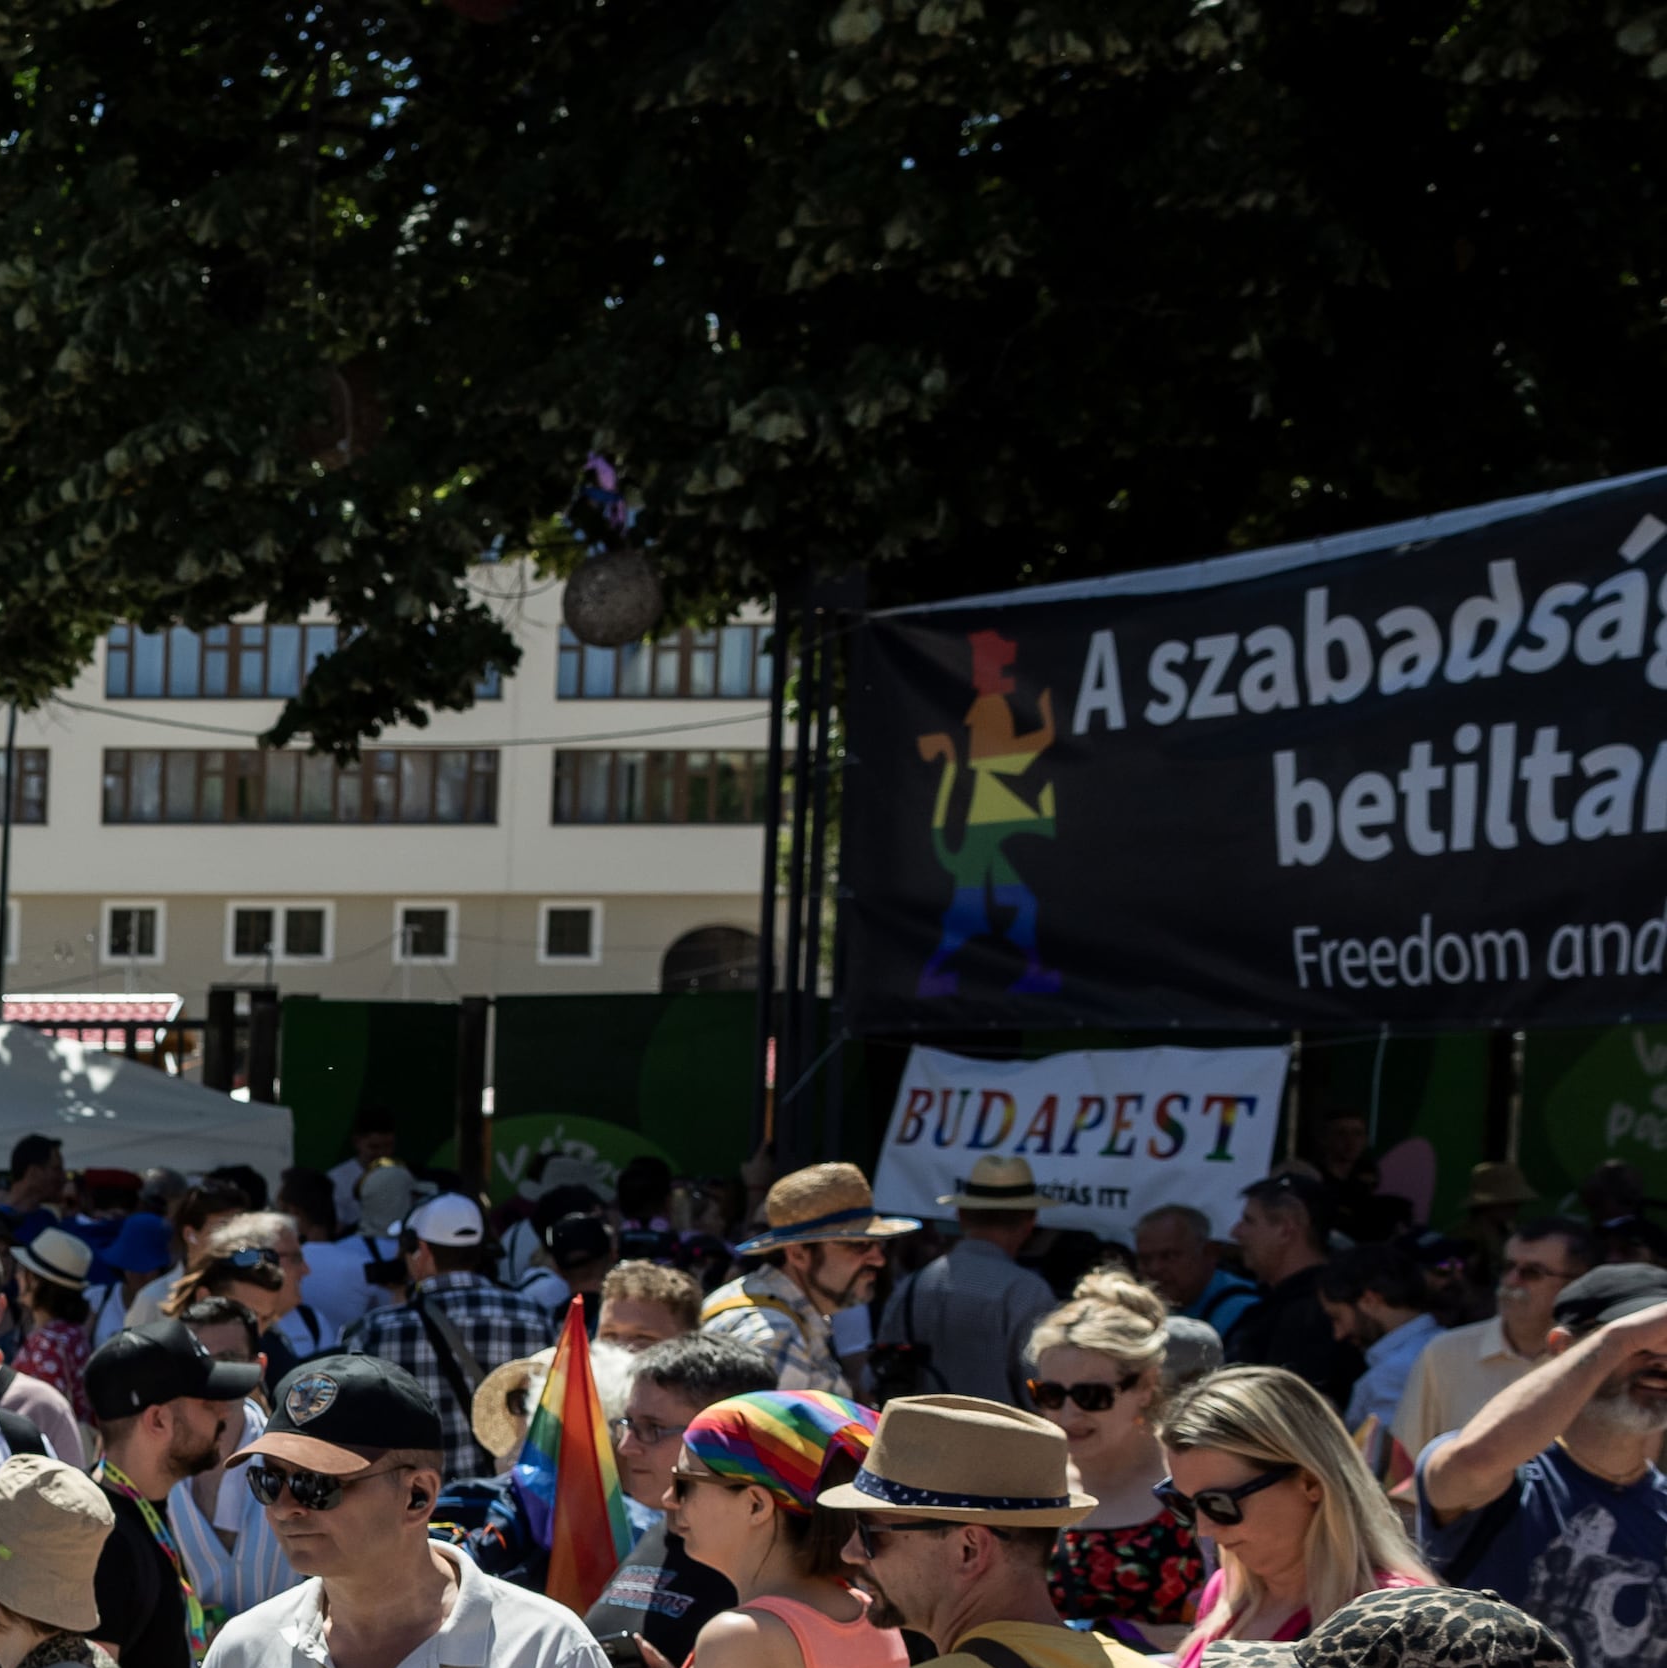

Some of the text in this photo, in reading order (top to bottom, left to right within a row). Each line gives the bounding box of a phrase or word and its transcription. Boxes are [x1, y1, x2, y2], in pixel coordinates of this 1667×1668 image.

[1073, 629, 1125, 735] A
[1294, 913, 1529, 990] Freedom
[896, 1088, 1257, 1162] BUDAPEST
[1098, 1186, 1131, 1209] ITT
